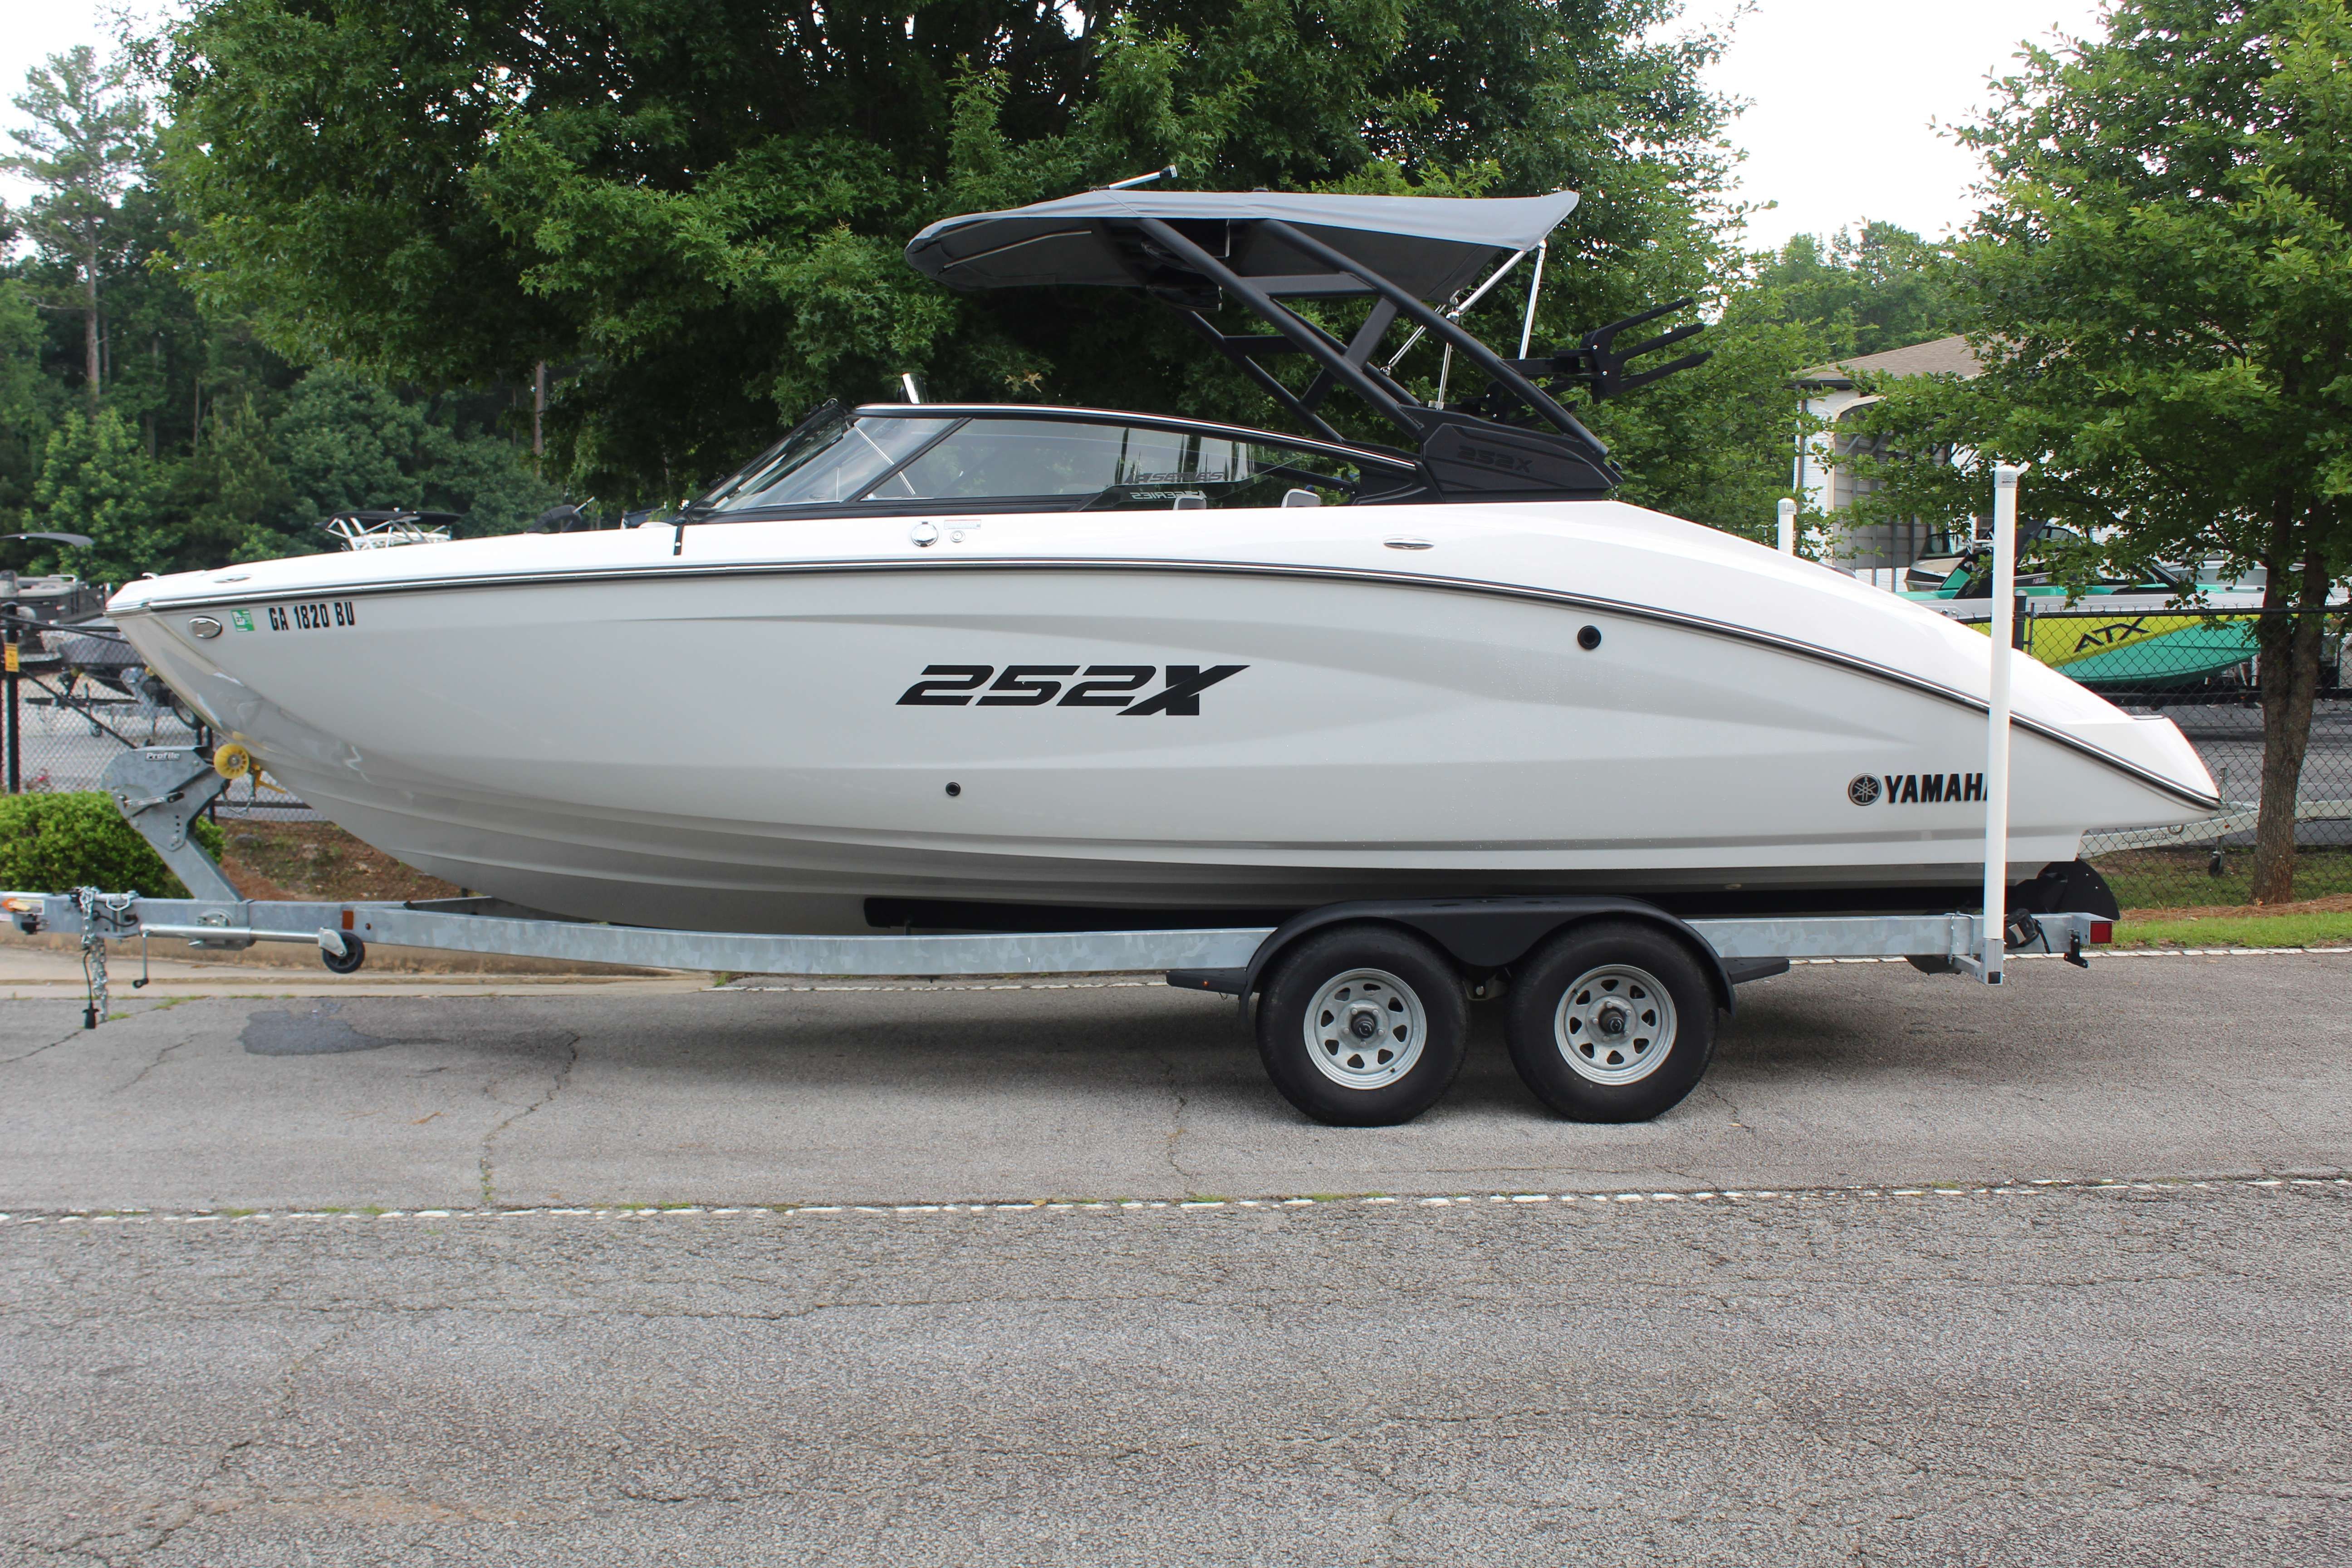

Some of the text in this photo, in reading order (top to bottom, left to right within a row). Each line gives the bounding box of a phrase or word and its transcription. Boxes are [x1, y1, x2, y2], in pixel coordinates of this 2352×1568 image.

[269, 602, 355, 631] GA 1820 BU
[2073, 616, 2151, 653] ATX
[895, 665, 1251, 716] 252X
[146, 752, 180, 760] Profile
[1884, 773, 1988, 804] YAMAH
